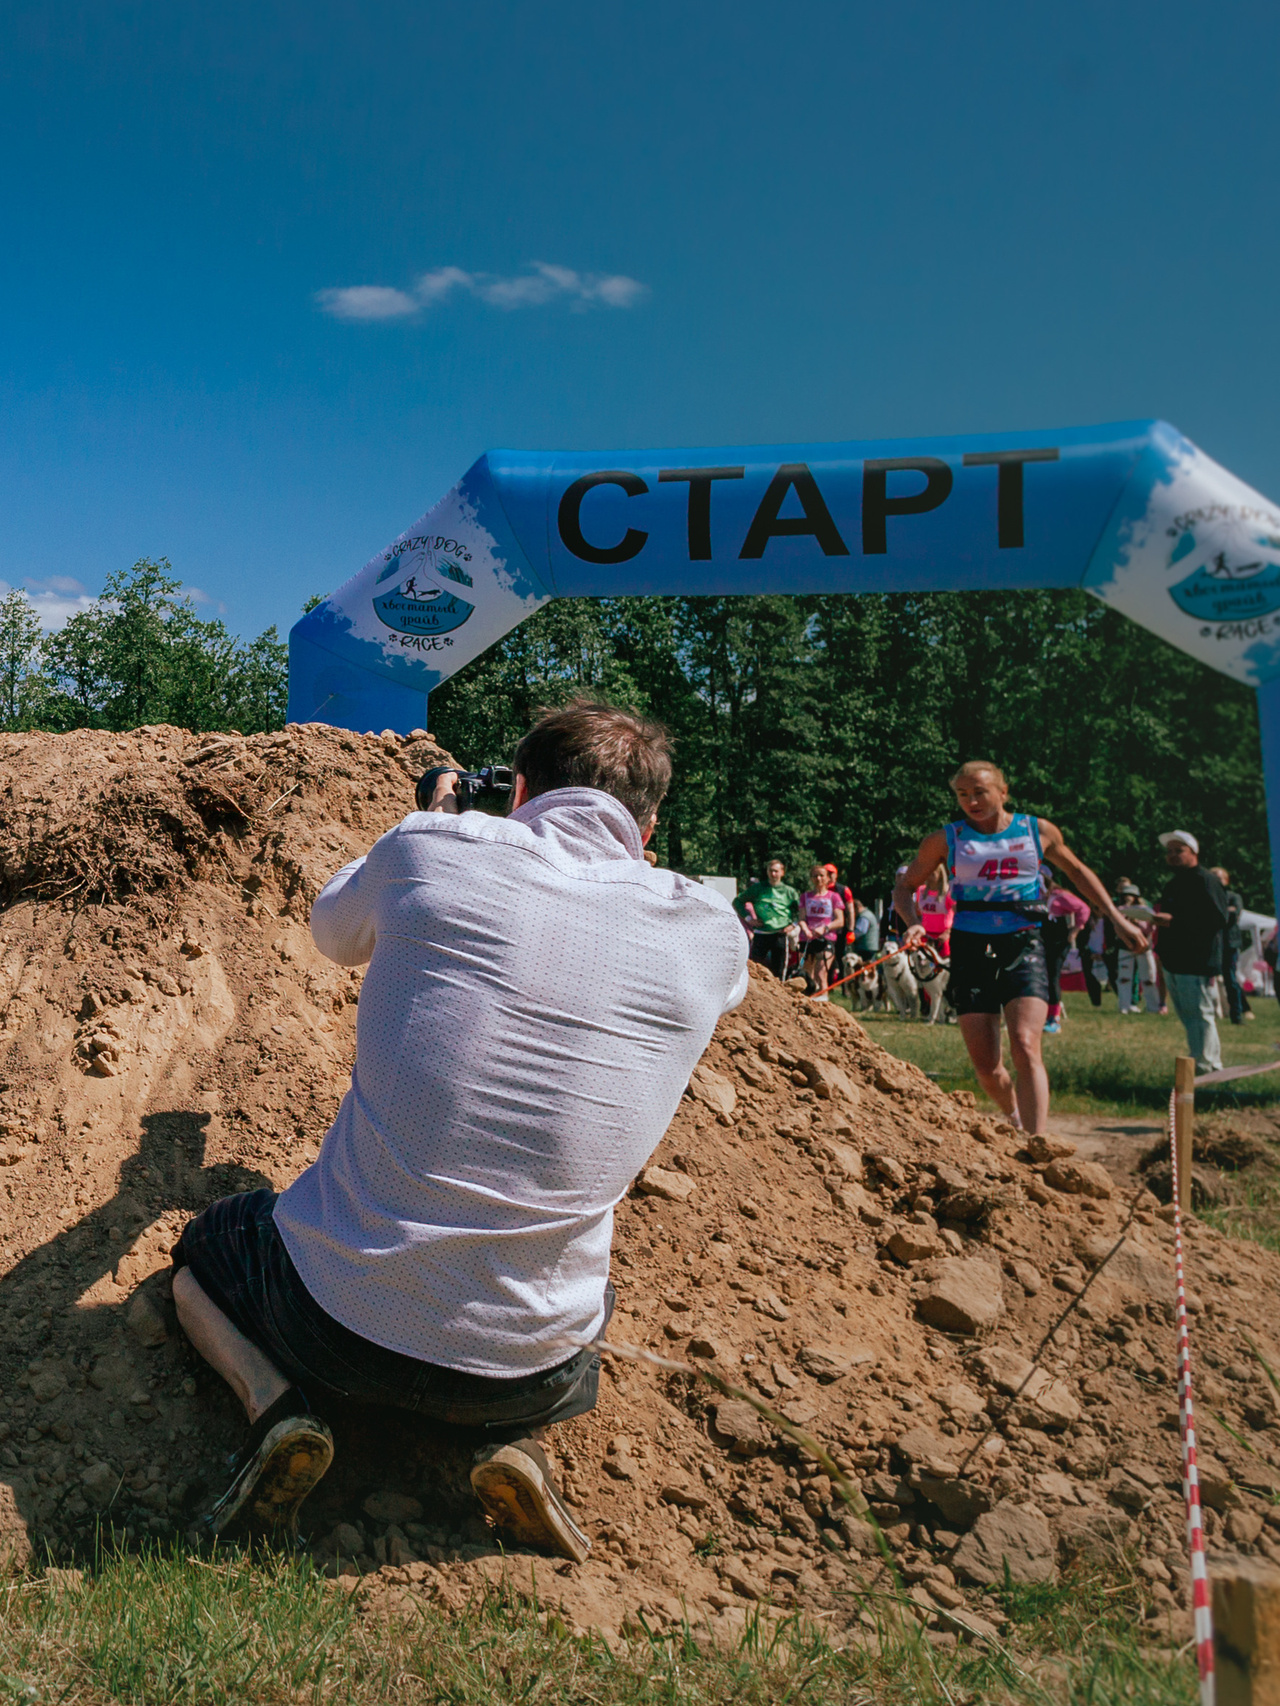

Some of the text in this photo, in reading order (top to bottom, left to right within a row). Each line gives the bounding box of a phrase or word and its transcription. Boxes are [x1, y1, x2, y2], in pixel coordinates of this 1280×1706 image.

[557, 448, 1060, 565] СТАРТ
[392, 535, 467, 558] CRAZY DOG
[1216, 619, 1271, 641] RACE
[400, 635, 444, 652] RACE
[977, 857, 1019, 881] 46
